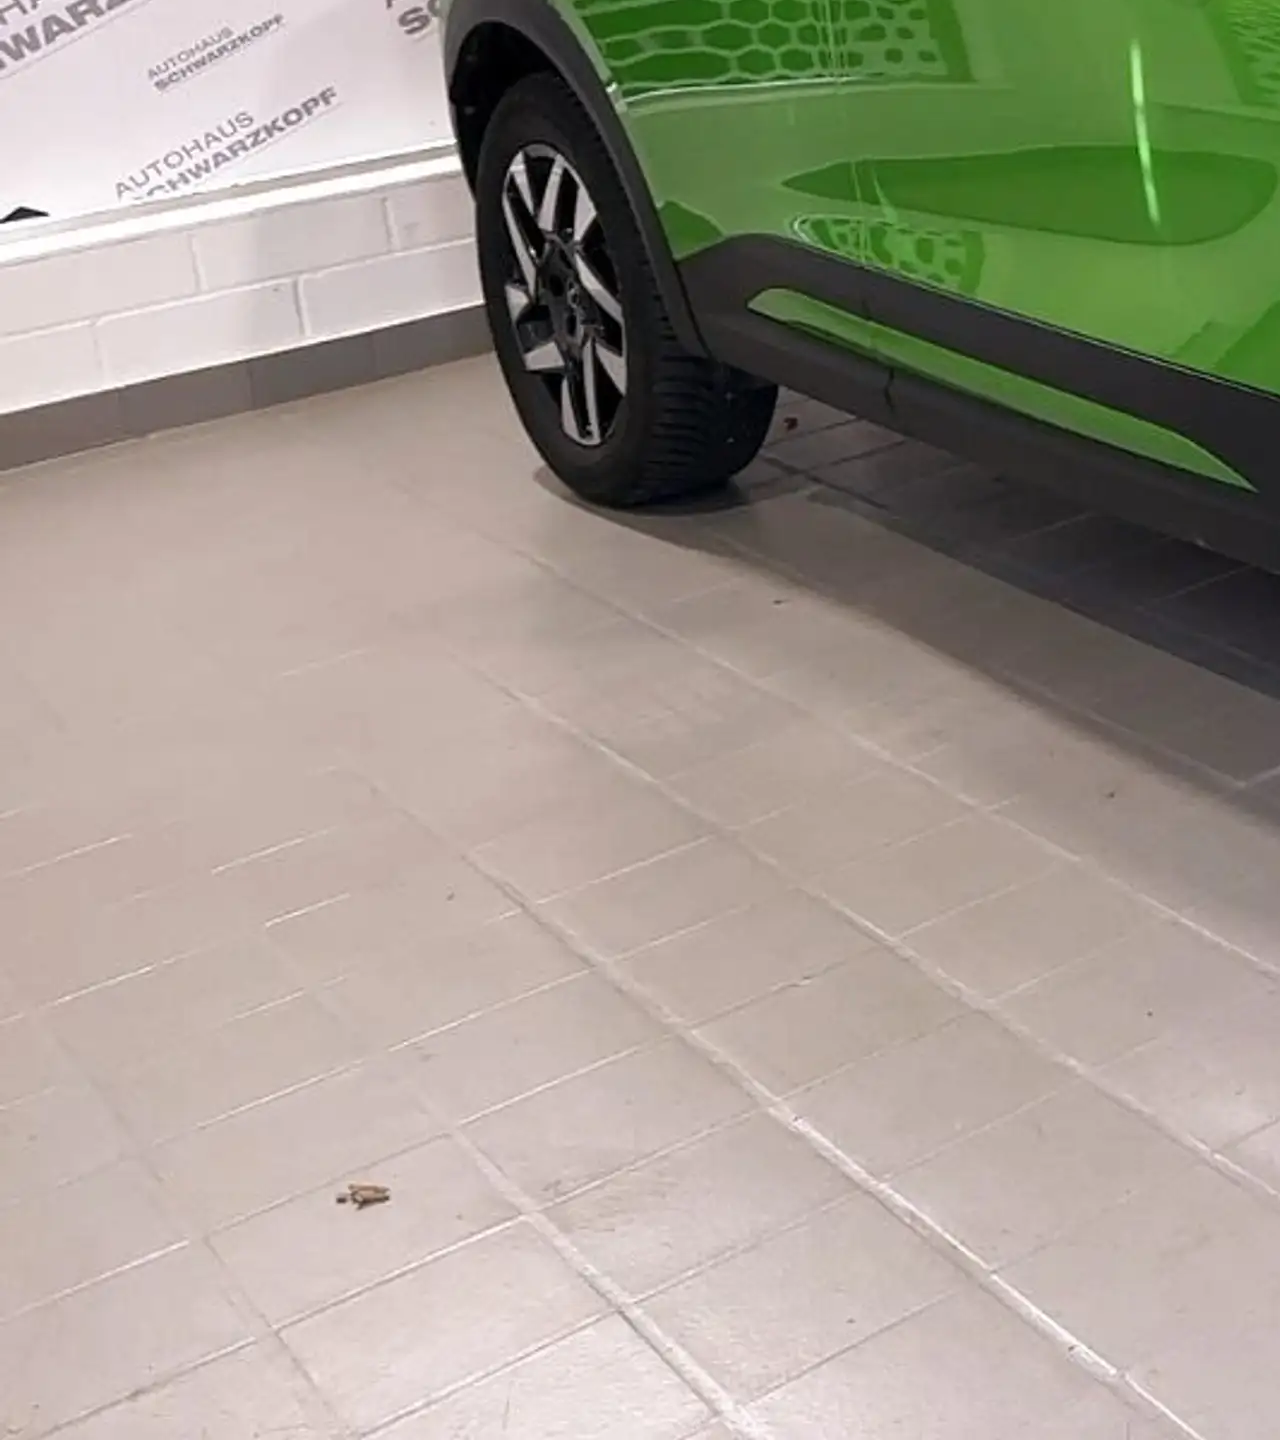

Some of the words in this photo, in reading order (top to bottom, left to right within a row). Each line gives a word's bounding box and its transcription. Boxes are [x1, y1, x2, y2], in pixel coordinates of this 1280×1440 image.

[147, 25, 235, 82] AUTOHAUS
[153, 12, 285, 92] SCHWARZKOPF
[115, 110, 255, 202] AUTOHAUS
